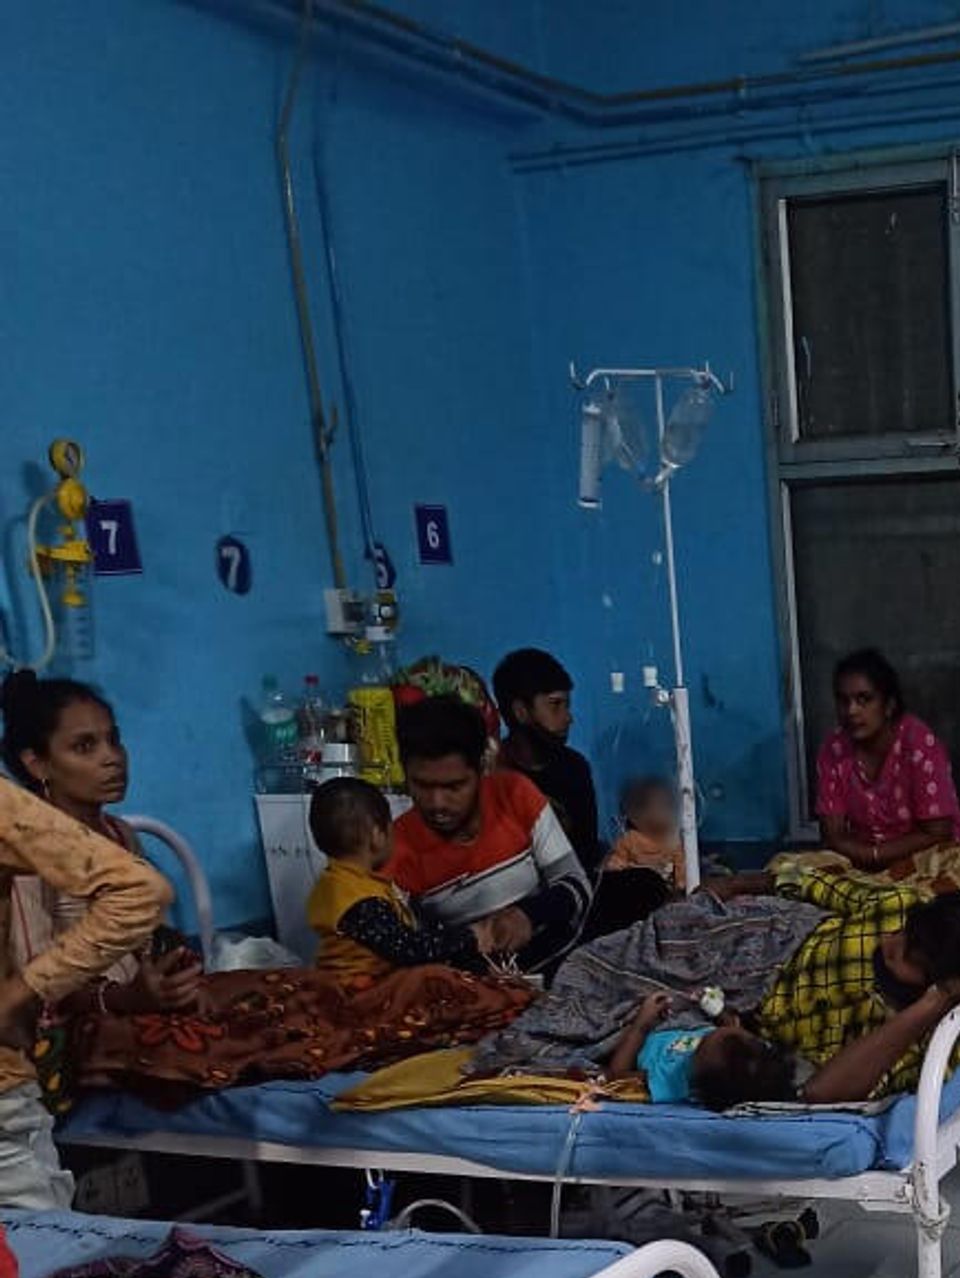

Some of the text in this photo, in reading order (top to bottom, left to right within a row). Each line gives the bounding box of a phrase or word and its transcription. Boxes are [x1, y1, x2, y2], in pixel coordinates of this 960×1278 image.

[101, 520, 118, 554] 7
[427, 521, 440, 549] 6
[221, 546, 241, 588] 7
